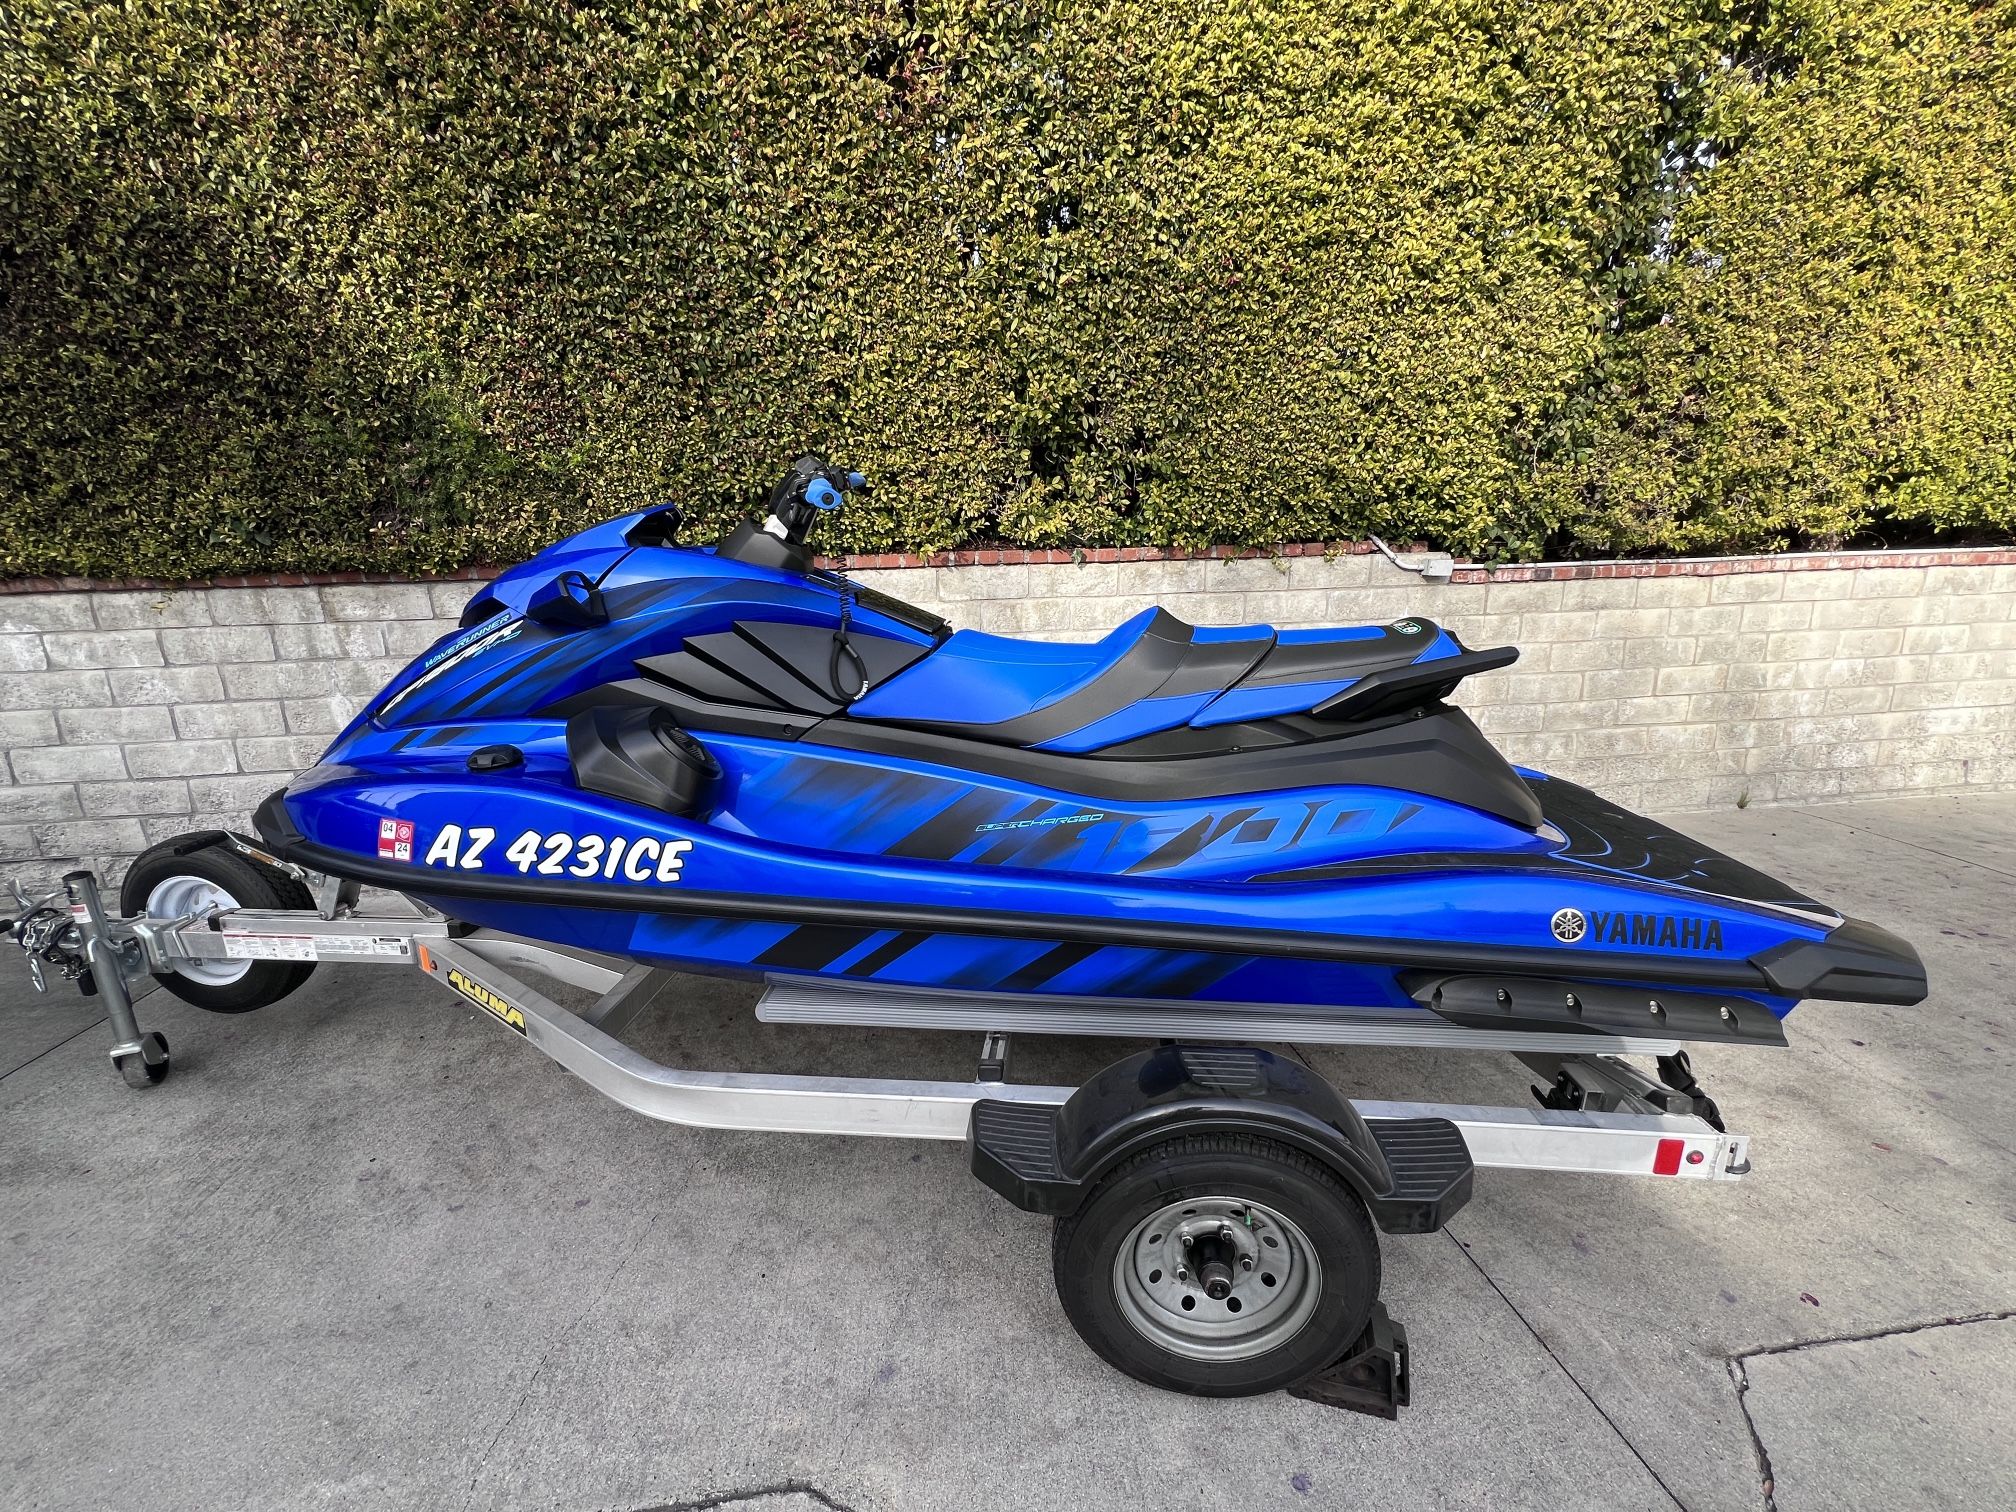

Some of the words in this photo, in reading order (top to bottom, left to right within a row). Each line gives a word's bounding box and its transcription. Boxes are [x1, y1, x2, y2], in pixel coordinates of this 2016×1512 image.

[383, 822, 393, 832] 04
[975, 813, 1105, 832] RCHARGED
[397, 842, 408, 852] 24
[425, 823, 496, 870] AZ
[504, 829, 694, 883] 4231CE
[1590, 911, 1723, 951] YAMAHA
[448, 967, 526, 1030] ALUMA
